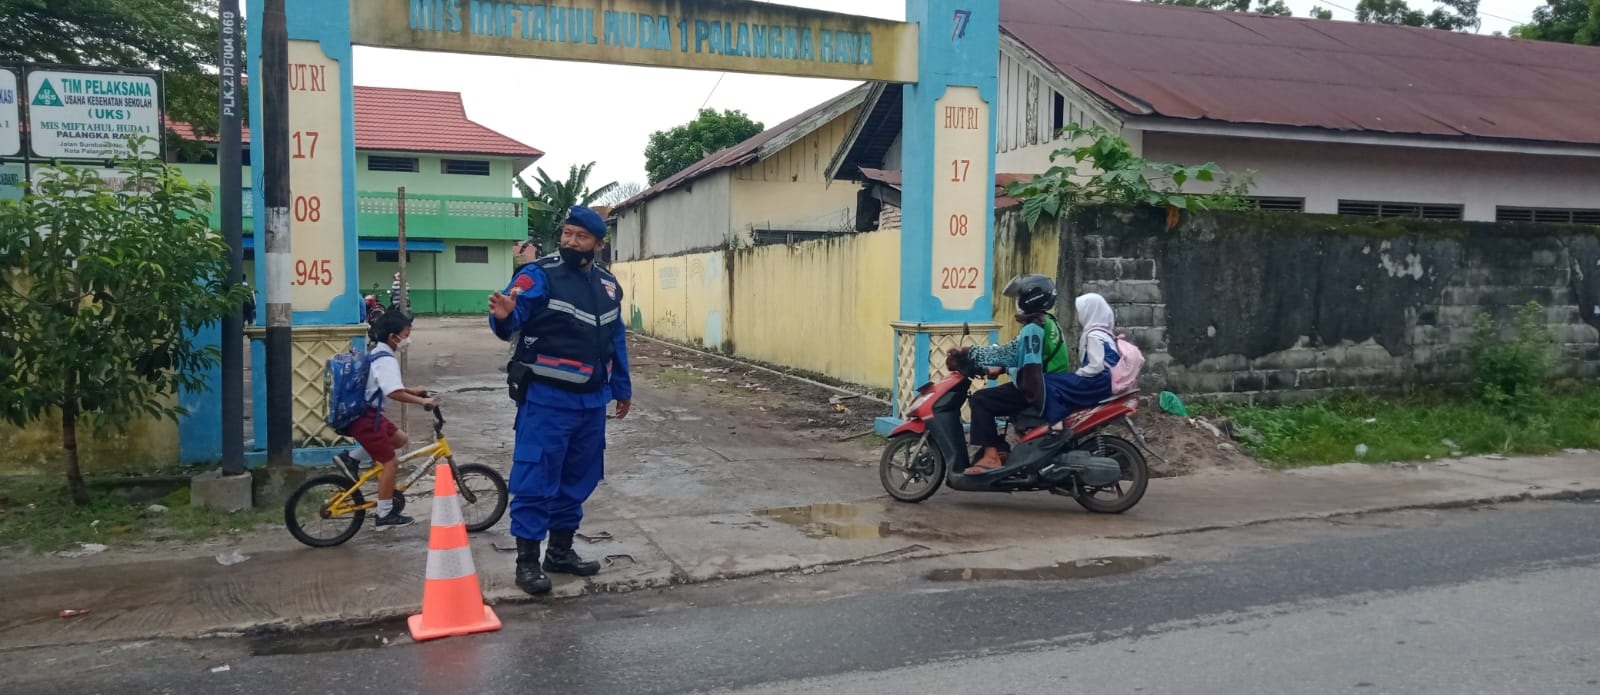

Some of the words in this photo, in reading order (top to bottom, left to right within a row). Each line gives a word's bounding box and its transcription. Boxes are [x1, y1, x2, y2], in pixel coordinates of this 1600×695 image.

[410, 0, 463, 32] MIS
[469, 0, 598, 45] MIFTAHUL
[604, 9, 672, 51] HUDA
[677, 18, 689, 53] 1
[695, 19, 815, 61] PALANGKA
[819, 28, 874, 65] RAYA
[61, 78, 81, 94] TIM
[85, 79, 152, 97] PELAKSANA
[64, 95, 86, 106] USAHA
[87, 96, 123, 107] KESEHATAN
[124, 98, 152, 109] SEKOLAH
[40, 121, 60, 130] MIS
[62, 122, 114, 132] MIFTAHUL
[117, 124, 144, 134] HUDA
[56, 131, 109, 140] PALANGKA
[292, 131, 319, 159] 17
[951, 159, 970, 183] 17
[294, 195, 321, 223] 08
[949, 213, 968, 236] 08
[290, 259, 332, 286] 945
[941, 266, 979, 290] 2022
